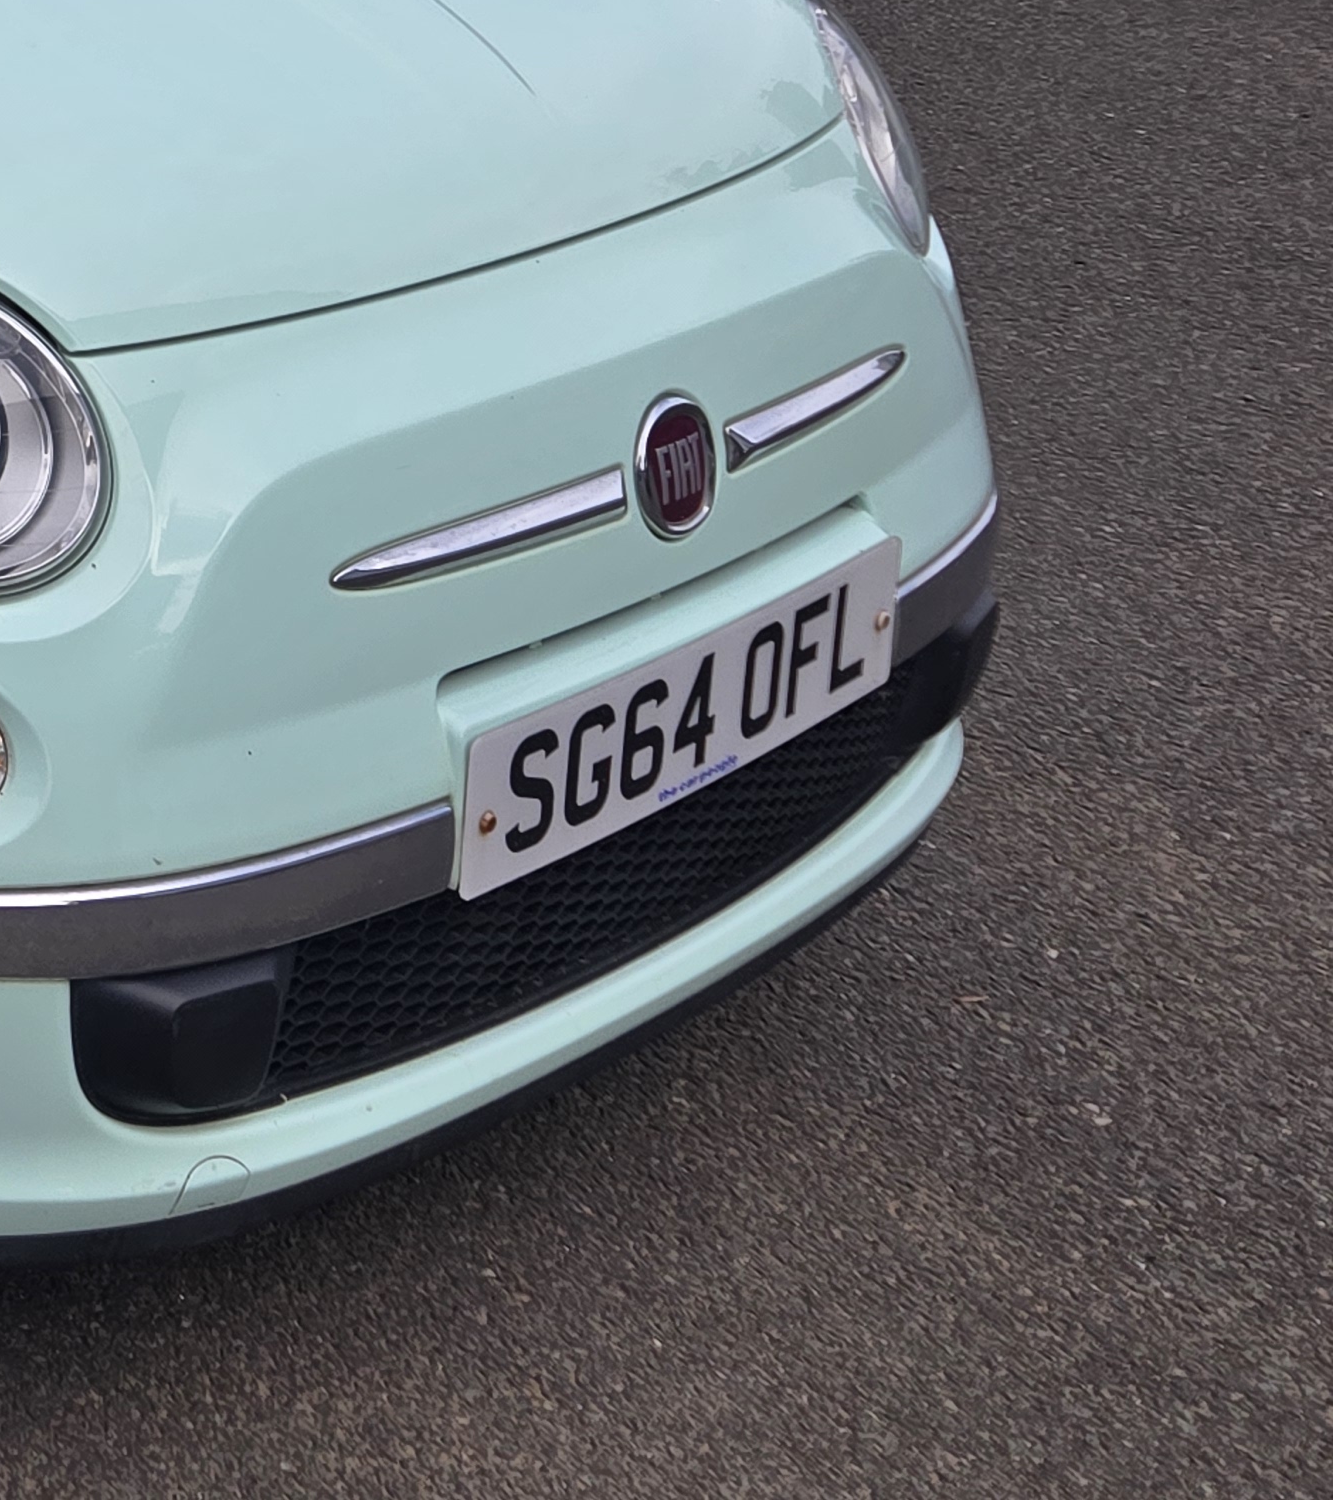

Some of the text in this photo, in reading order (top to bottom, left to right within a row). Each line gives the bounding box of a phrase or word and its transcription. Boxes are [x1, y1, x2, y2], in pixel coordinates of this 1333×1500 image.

[654, 430, 704, 506] FIAT
[505, 583, 865, 854] SG64 OFL
